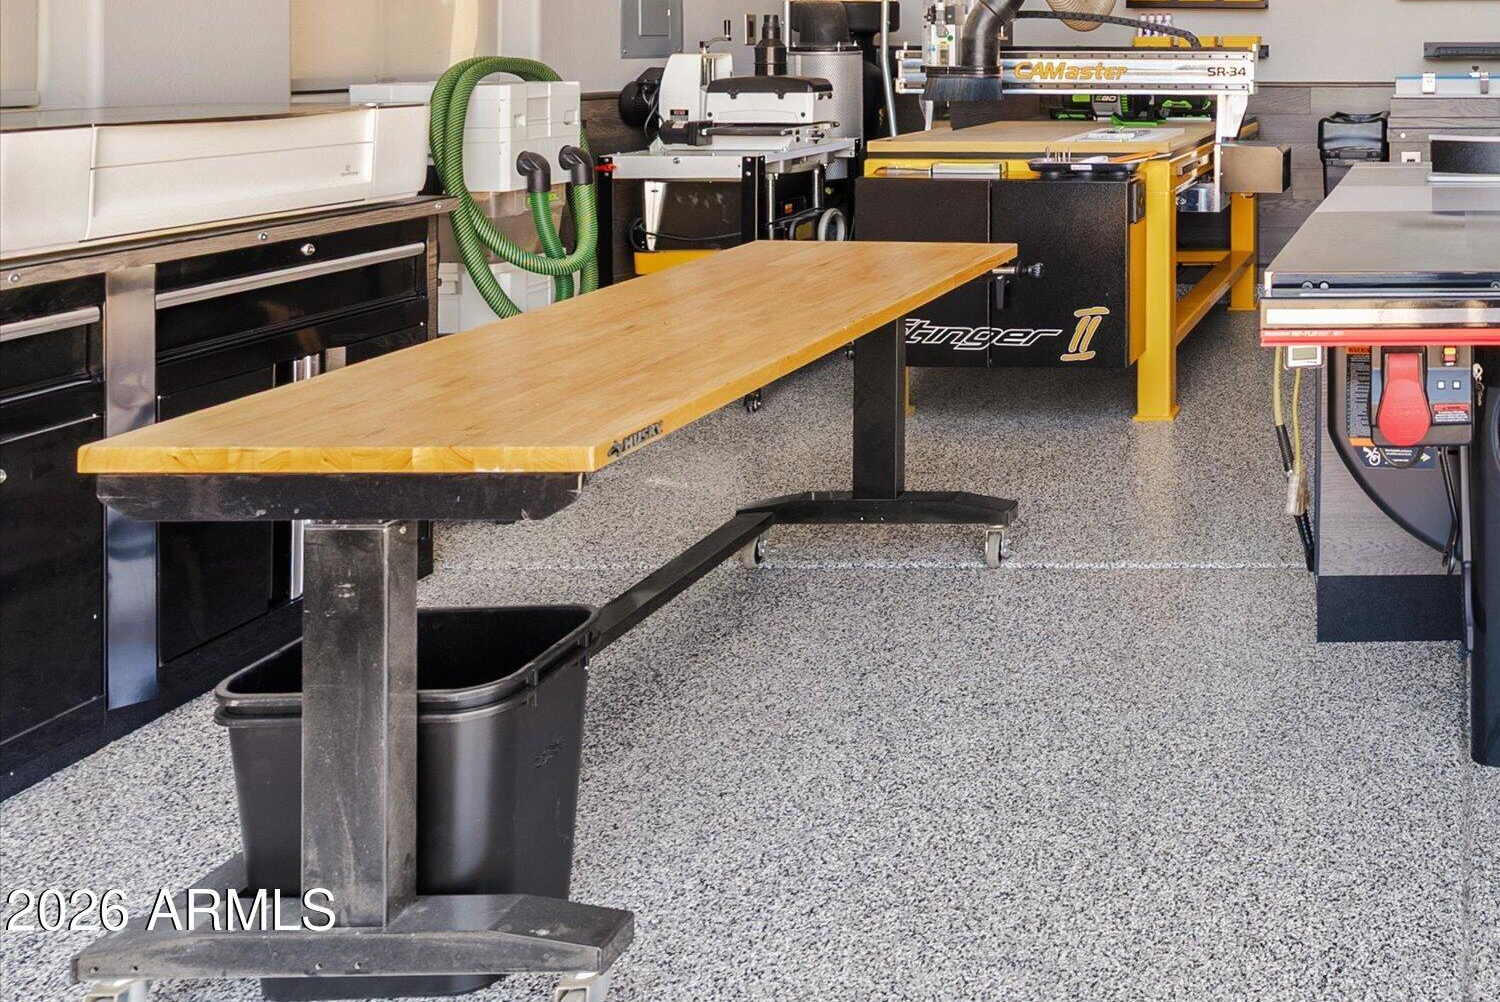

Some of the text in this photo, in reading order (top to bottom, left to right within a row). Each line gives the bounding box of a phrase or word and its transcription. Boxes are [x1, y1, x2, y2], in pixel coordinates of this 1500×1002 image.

[1014, 61, 1128, 81] CAMaster
[1207, 67, 1247, 77] SR-34
[906, 319, 1063, 351] tinger
[621, 420, 663, 452] HUSKY
